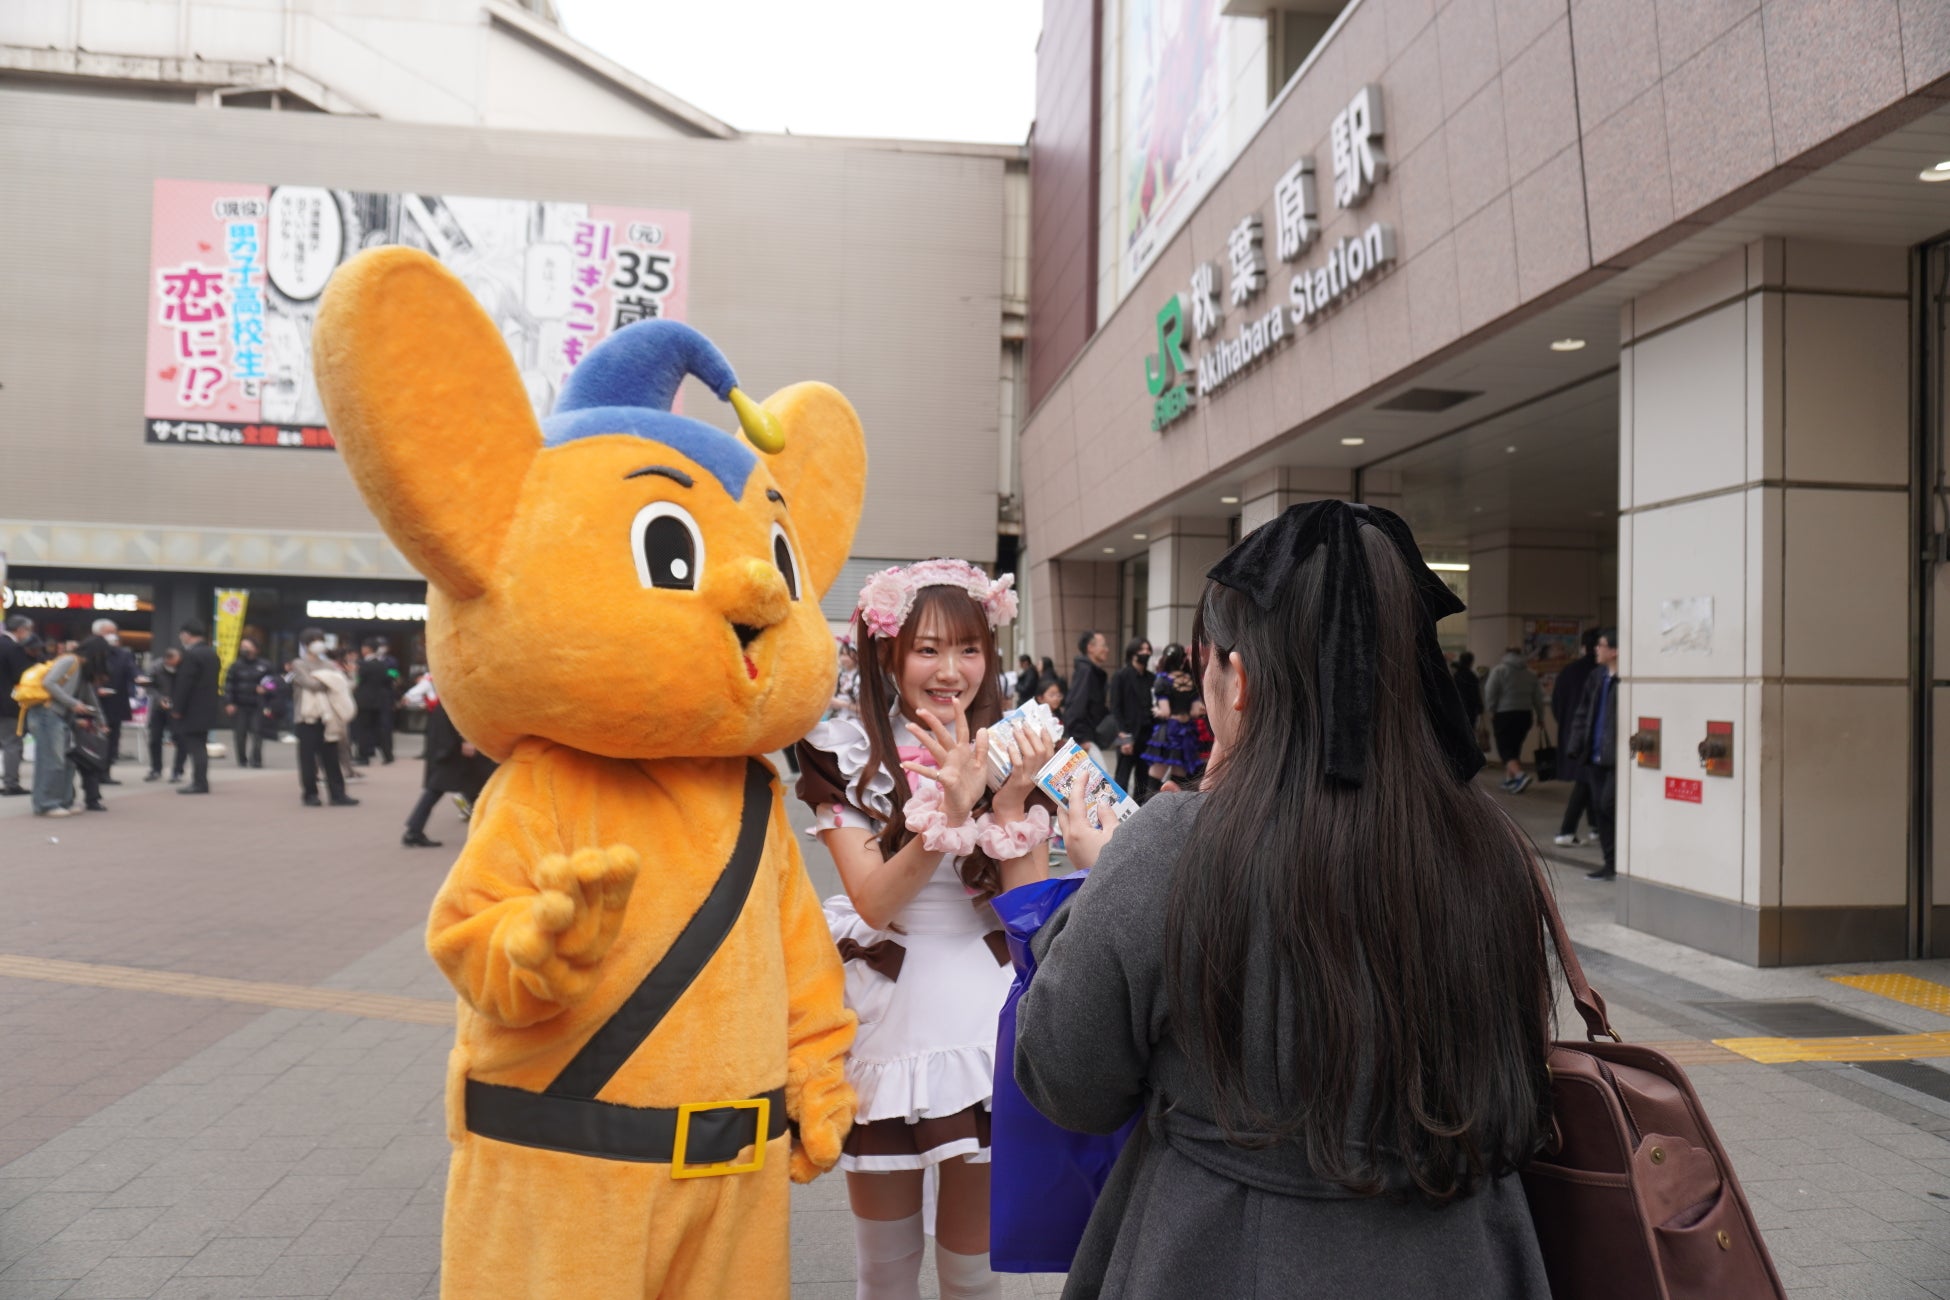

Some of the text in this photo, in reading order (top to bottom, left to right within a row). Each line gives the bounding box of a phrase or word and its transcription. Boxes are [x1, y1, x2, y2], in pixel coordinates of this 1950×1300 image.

[1190, 84, 1376, 341] 秋葉原駅
[560, 221, 611, 387] 引きこも
[1145, 292, 1188, 396] JR
[1197, 220, 1386, 398] Akihabara Station
[14, 589, 69, 609] TOKYO
